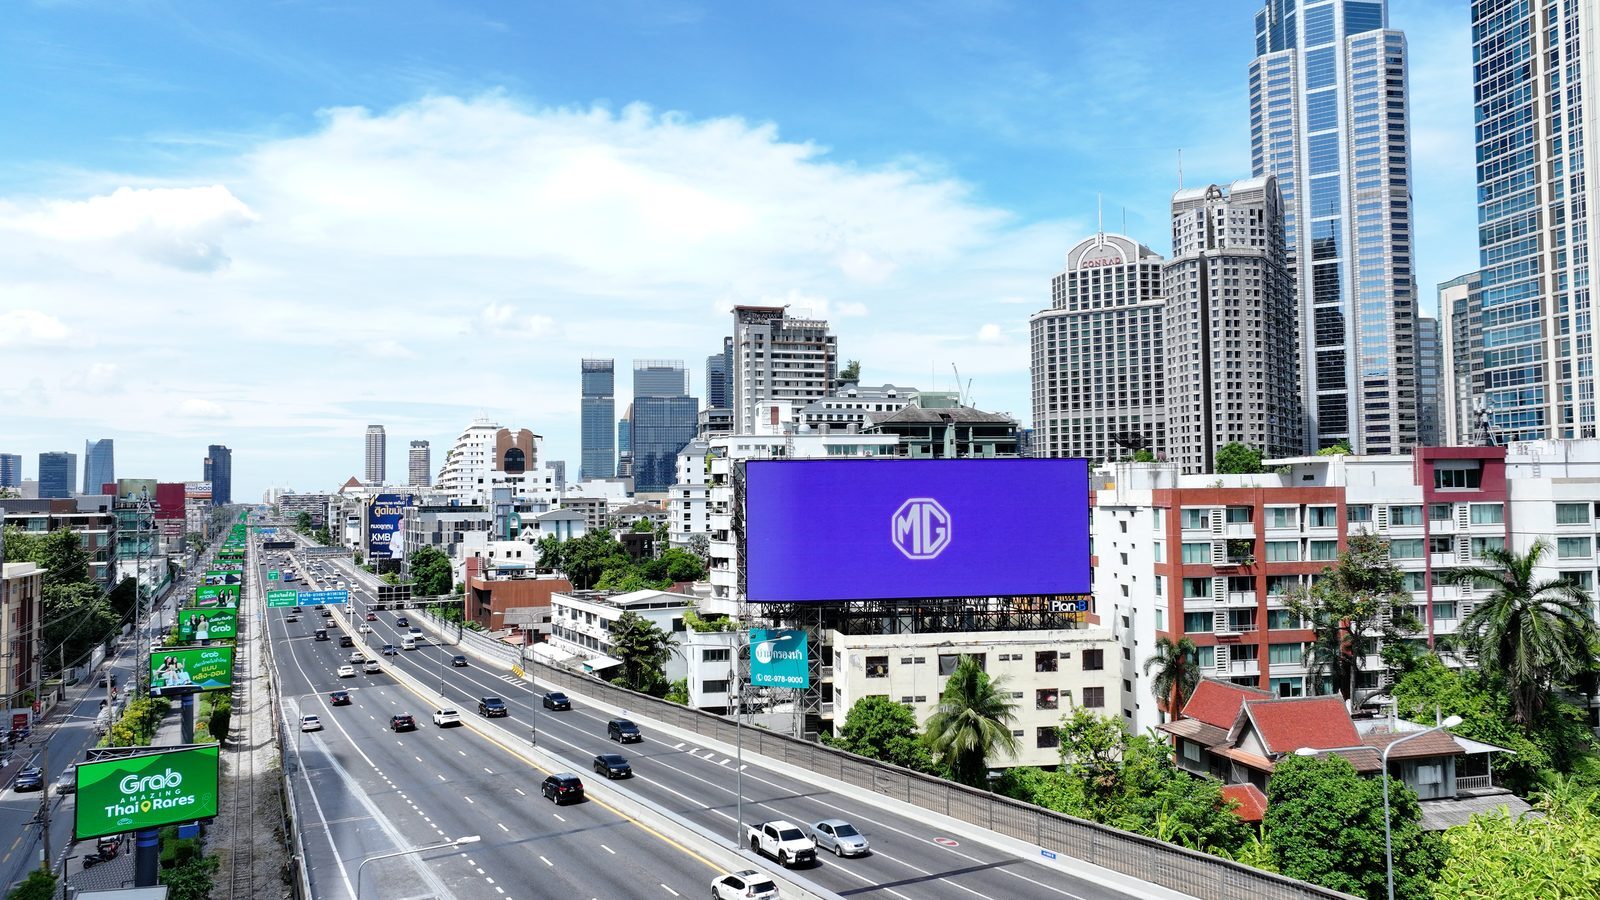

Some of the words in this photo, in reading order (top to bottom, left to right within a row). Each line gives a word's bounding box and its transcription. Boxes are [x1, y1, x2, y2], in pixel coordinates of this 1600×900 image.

[1082, 257, 1121, 268] CONRAD
[897, 503, 946, 554] MG
[371, 533, 391, 541] KMB
[210, 624, 231, 632] Grab
[201, 651, 219, 659] Grab
[763, 674, 803, 684] 02-978-9000
[119, 768, 182, 794] Grab
[120, 789, 181, 804] AMAZING
[105, 801, 139, 818] Thai
[152, 794, 195, 810] Rares
